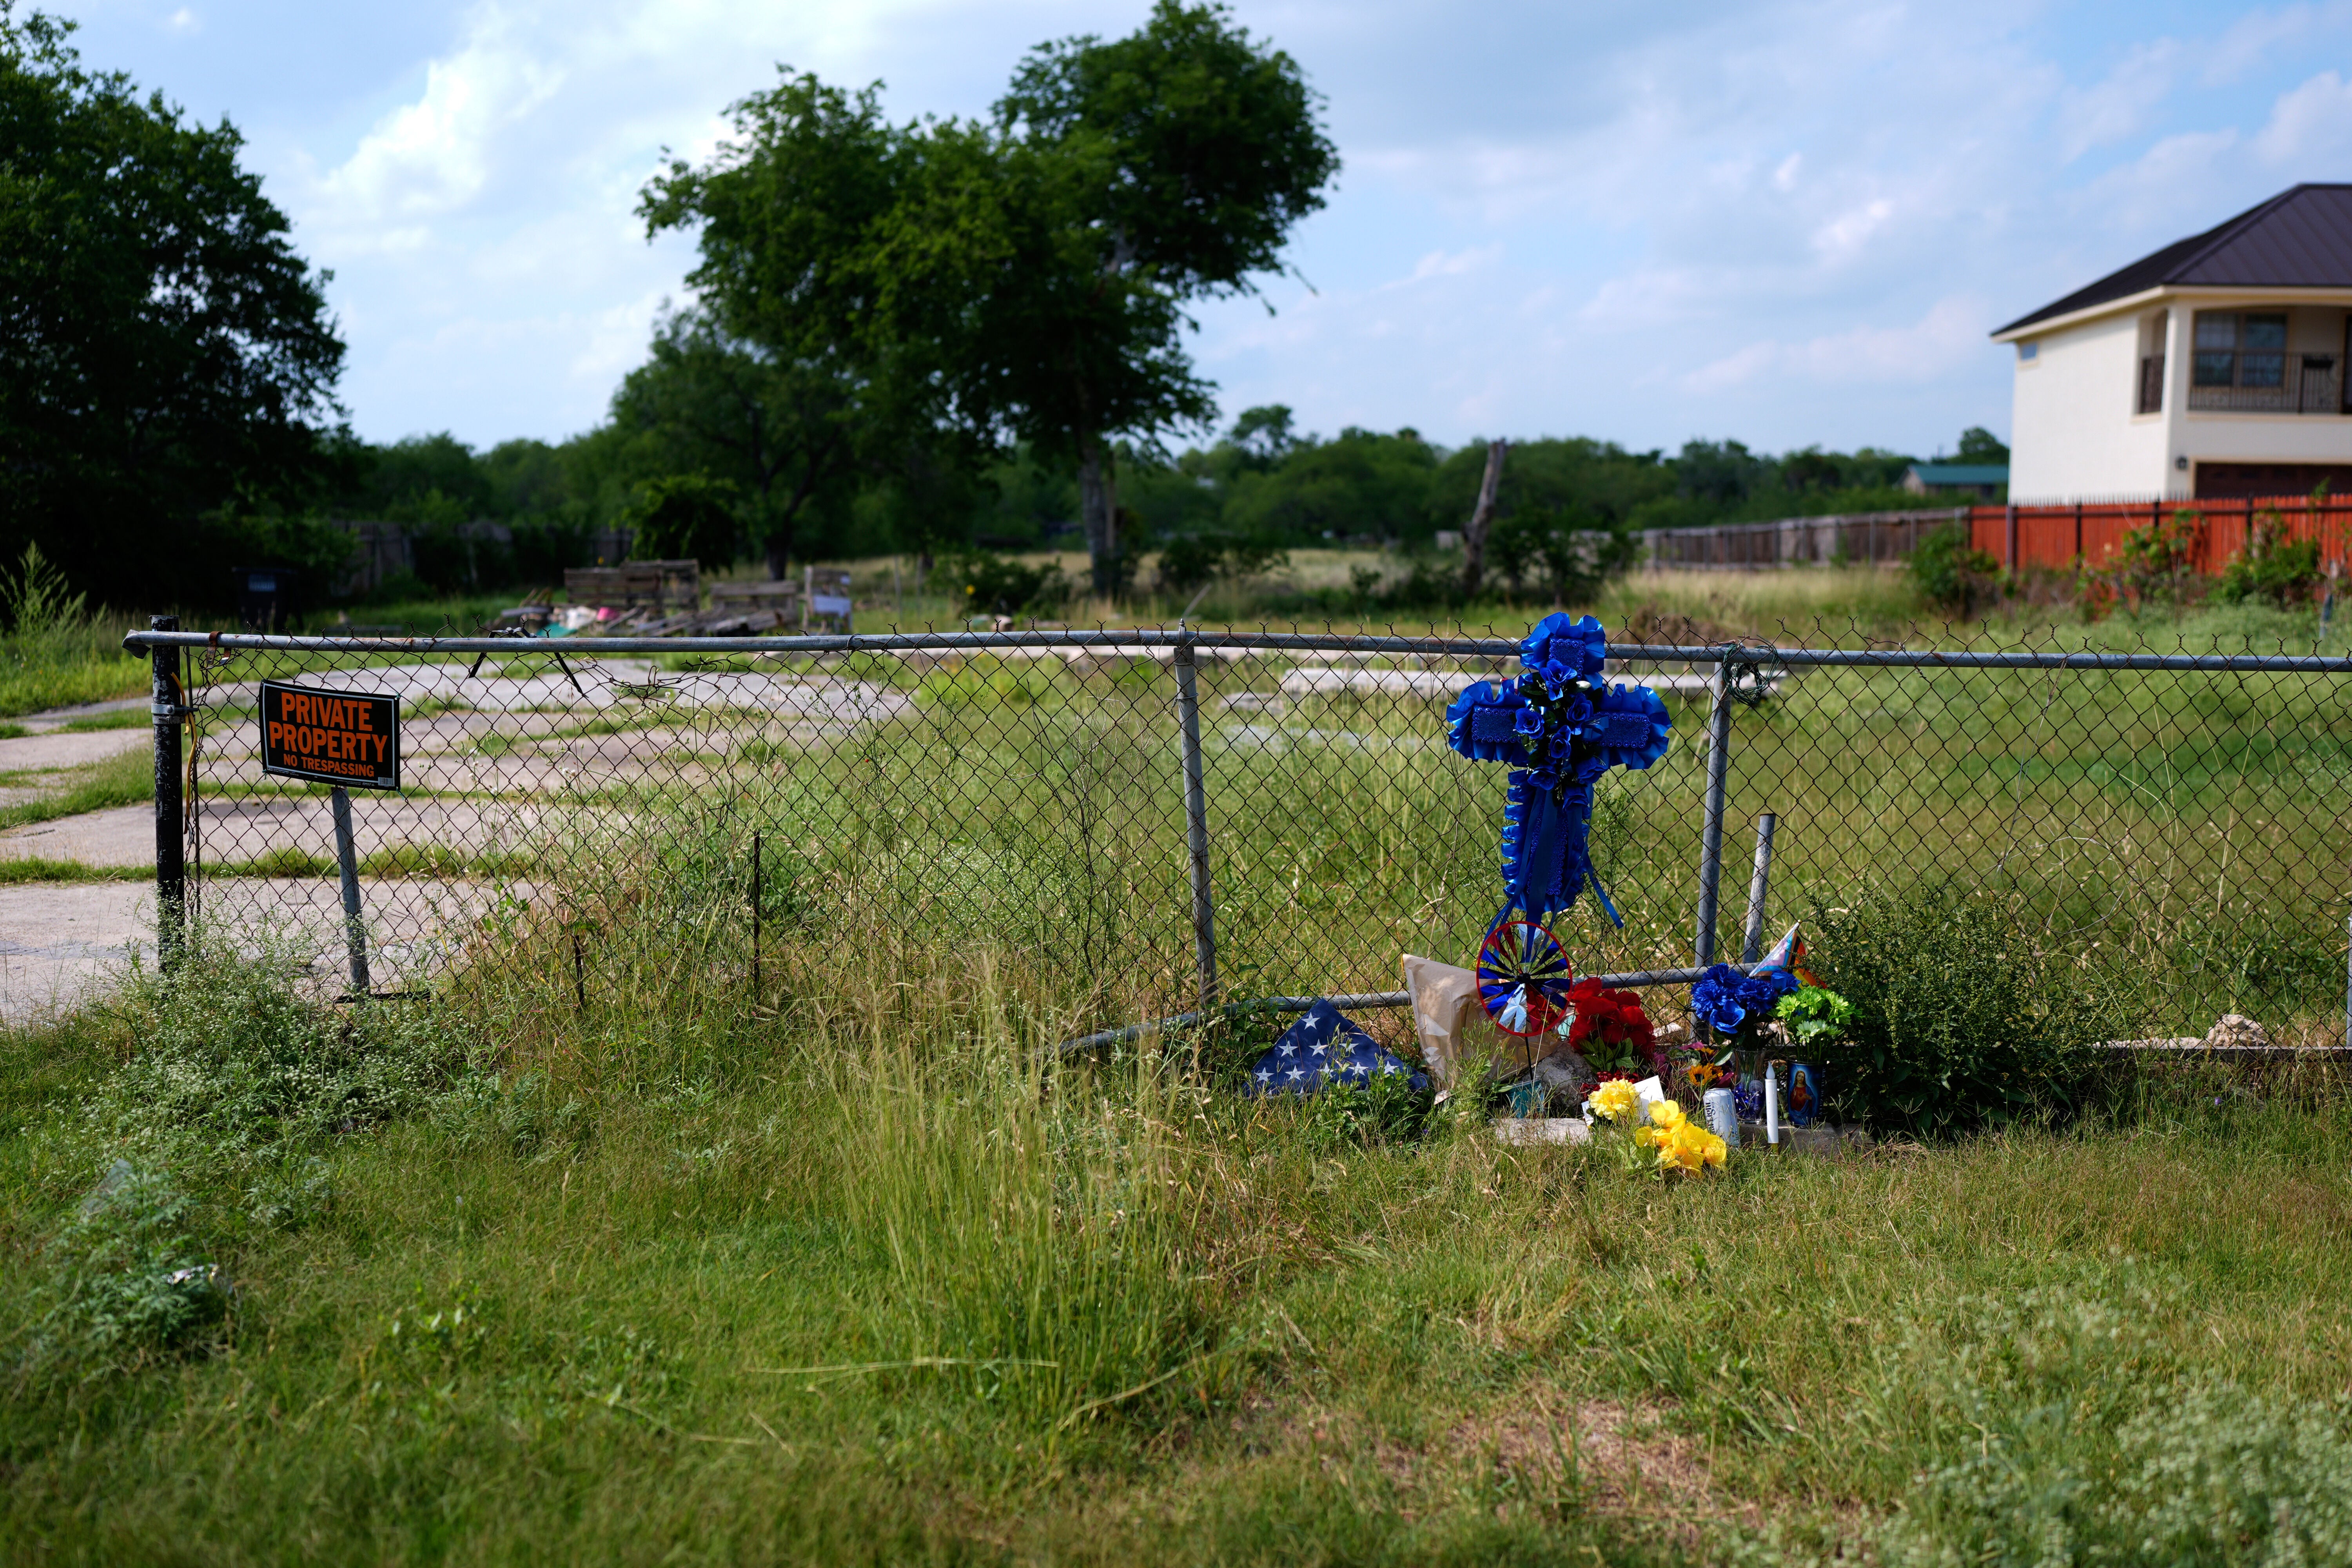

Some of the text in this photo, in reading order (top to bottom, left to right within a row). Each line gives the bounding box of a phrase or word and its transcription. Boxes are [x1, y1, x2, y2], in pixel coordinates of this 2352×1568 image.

[281, 692, 373, 731] PRIVATE
[269, 721, 388, 762] PROPERTY
[283, 753, 298, 767] NO
[301, 756, 374, 777] TRESPASSING
